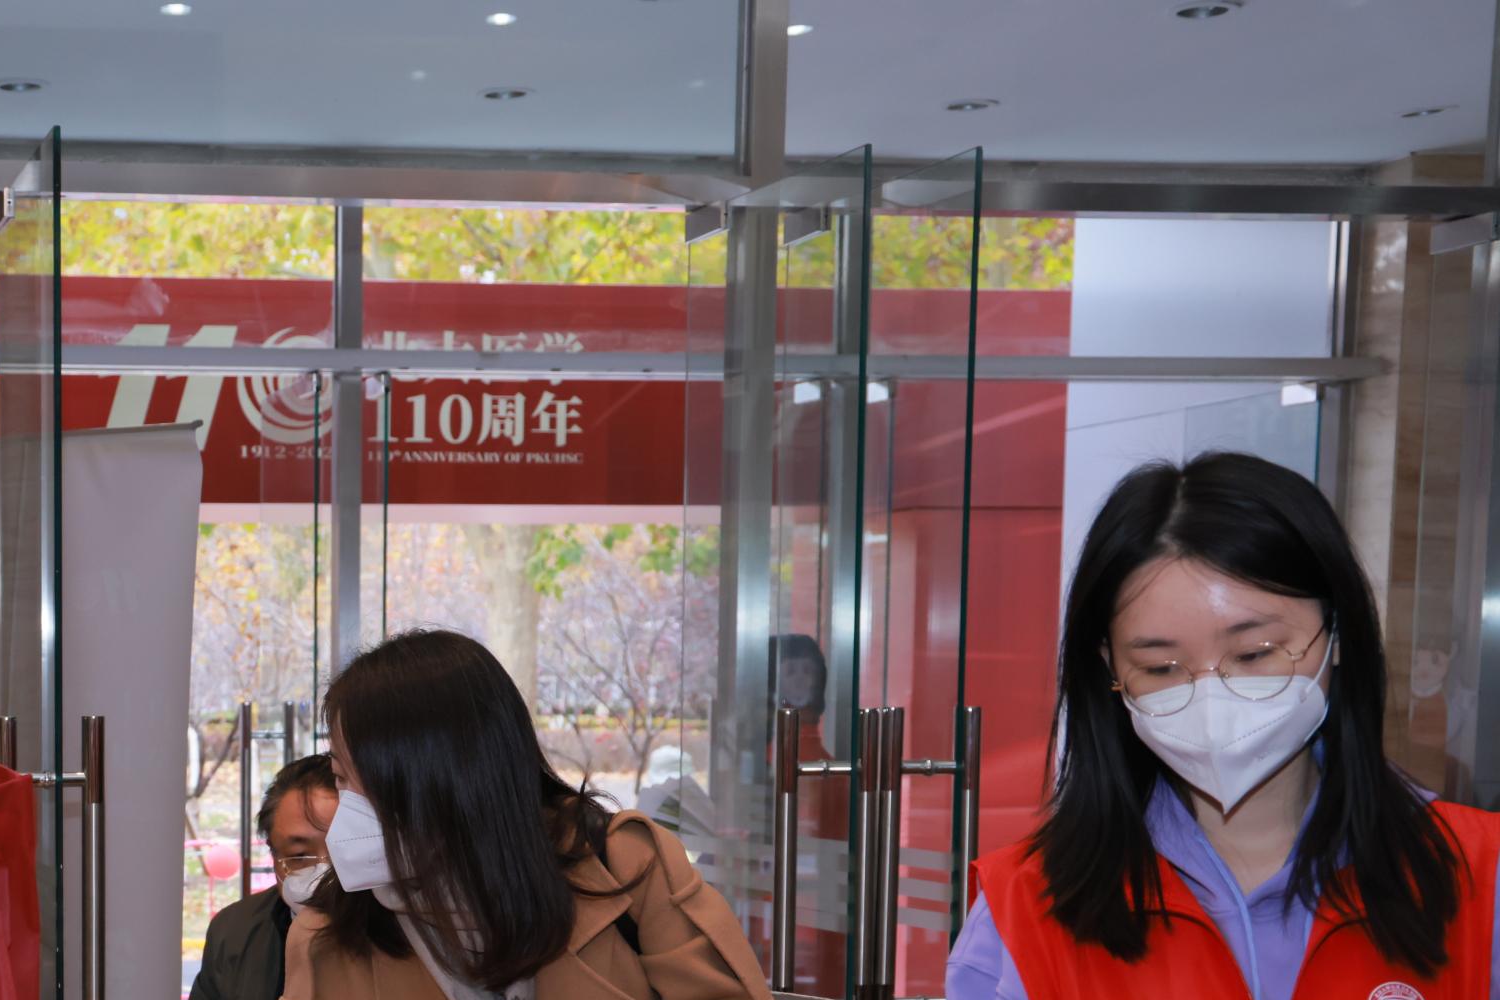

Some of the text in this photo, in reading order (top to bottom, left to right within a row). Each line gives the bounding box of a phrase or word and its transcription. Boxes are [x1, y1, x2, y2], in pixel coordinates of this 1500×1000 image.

[368, 391, 583, 447] 110周年
[403, 451, 499, 463] ANNIVERSARY
[504, 452, 521, 463] OF
